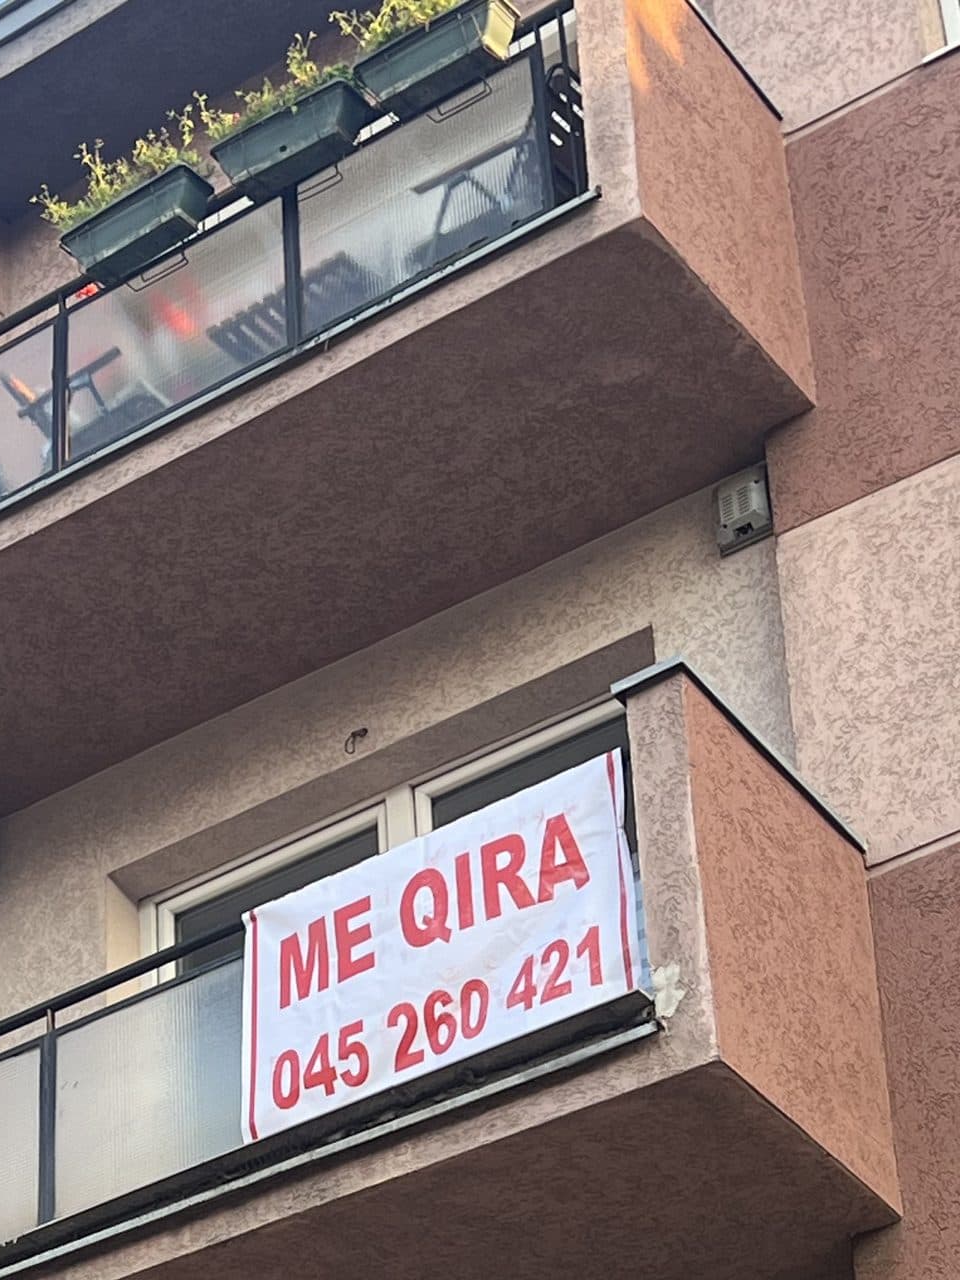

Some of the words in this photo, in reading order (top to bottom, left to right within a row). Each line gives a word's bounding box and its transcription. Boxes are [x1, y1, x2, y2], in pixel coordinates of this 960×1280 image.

[279, 895, 375, 1010] ME
[399, 812, 591, 948] QIRA
[272, 1018, 370, 1110] 045
[386, 977, 490, 1073] 260
[505, 924, 603, 1012] 421
